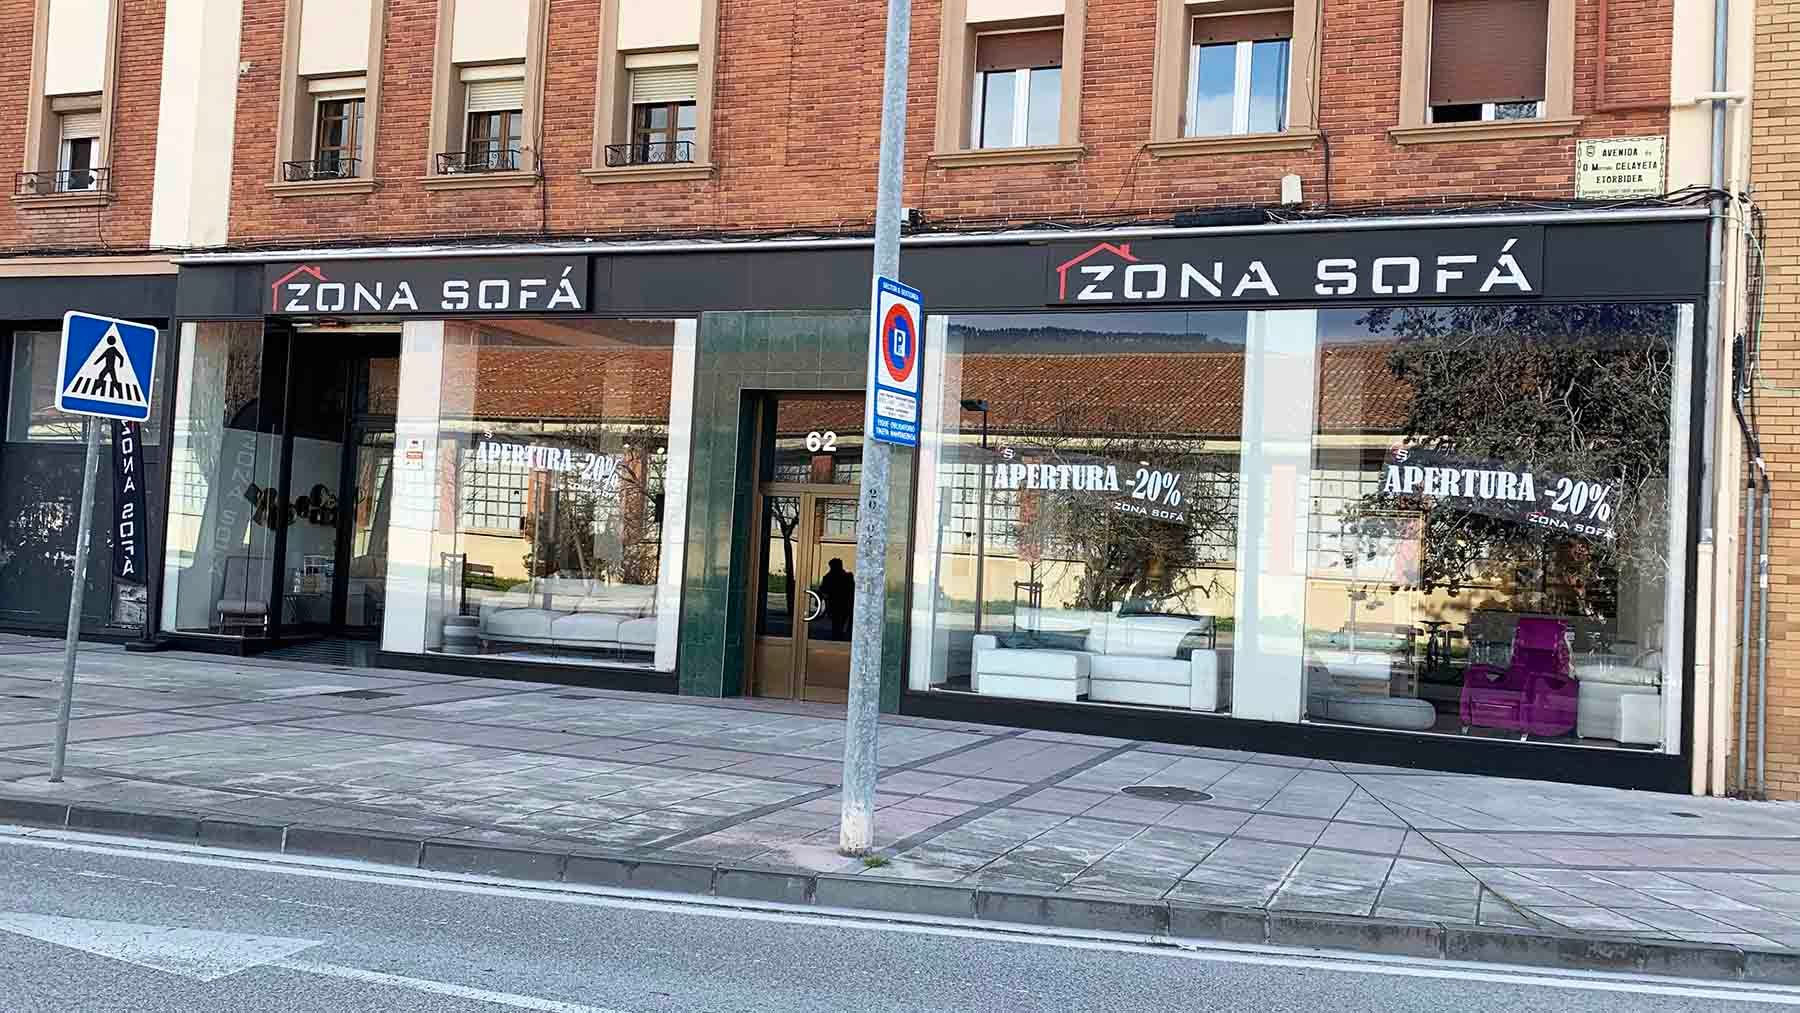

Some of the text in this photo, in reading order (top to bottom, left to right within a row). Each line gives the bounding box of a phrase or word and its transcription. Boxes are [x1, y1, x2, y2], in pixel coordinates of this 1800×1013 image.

[1602, 148, 1638, 157] AVENIDA
[1596, 175, 1643, 184] ETORBIDEA
[1077, 238, 1533, 300] ZONA SOFÁ
[285, 266, 582, 312] ZONA SOFÁ
[806, 431, 837, 452] 62
[476, 441, 573, 472] APERTURA
[993, 463, 1184, 506] APERTURA -20%
[1384, 464, 1613, 522] APERTURA -20%
[1113, 502, 1185, 522] ZONA SOFÁ
[1529, 514, 1569, 529] ZONA
